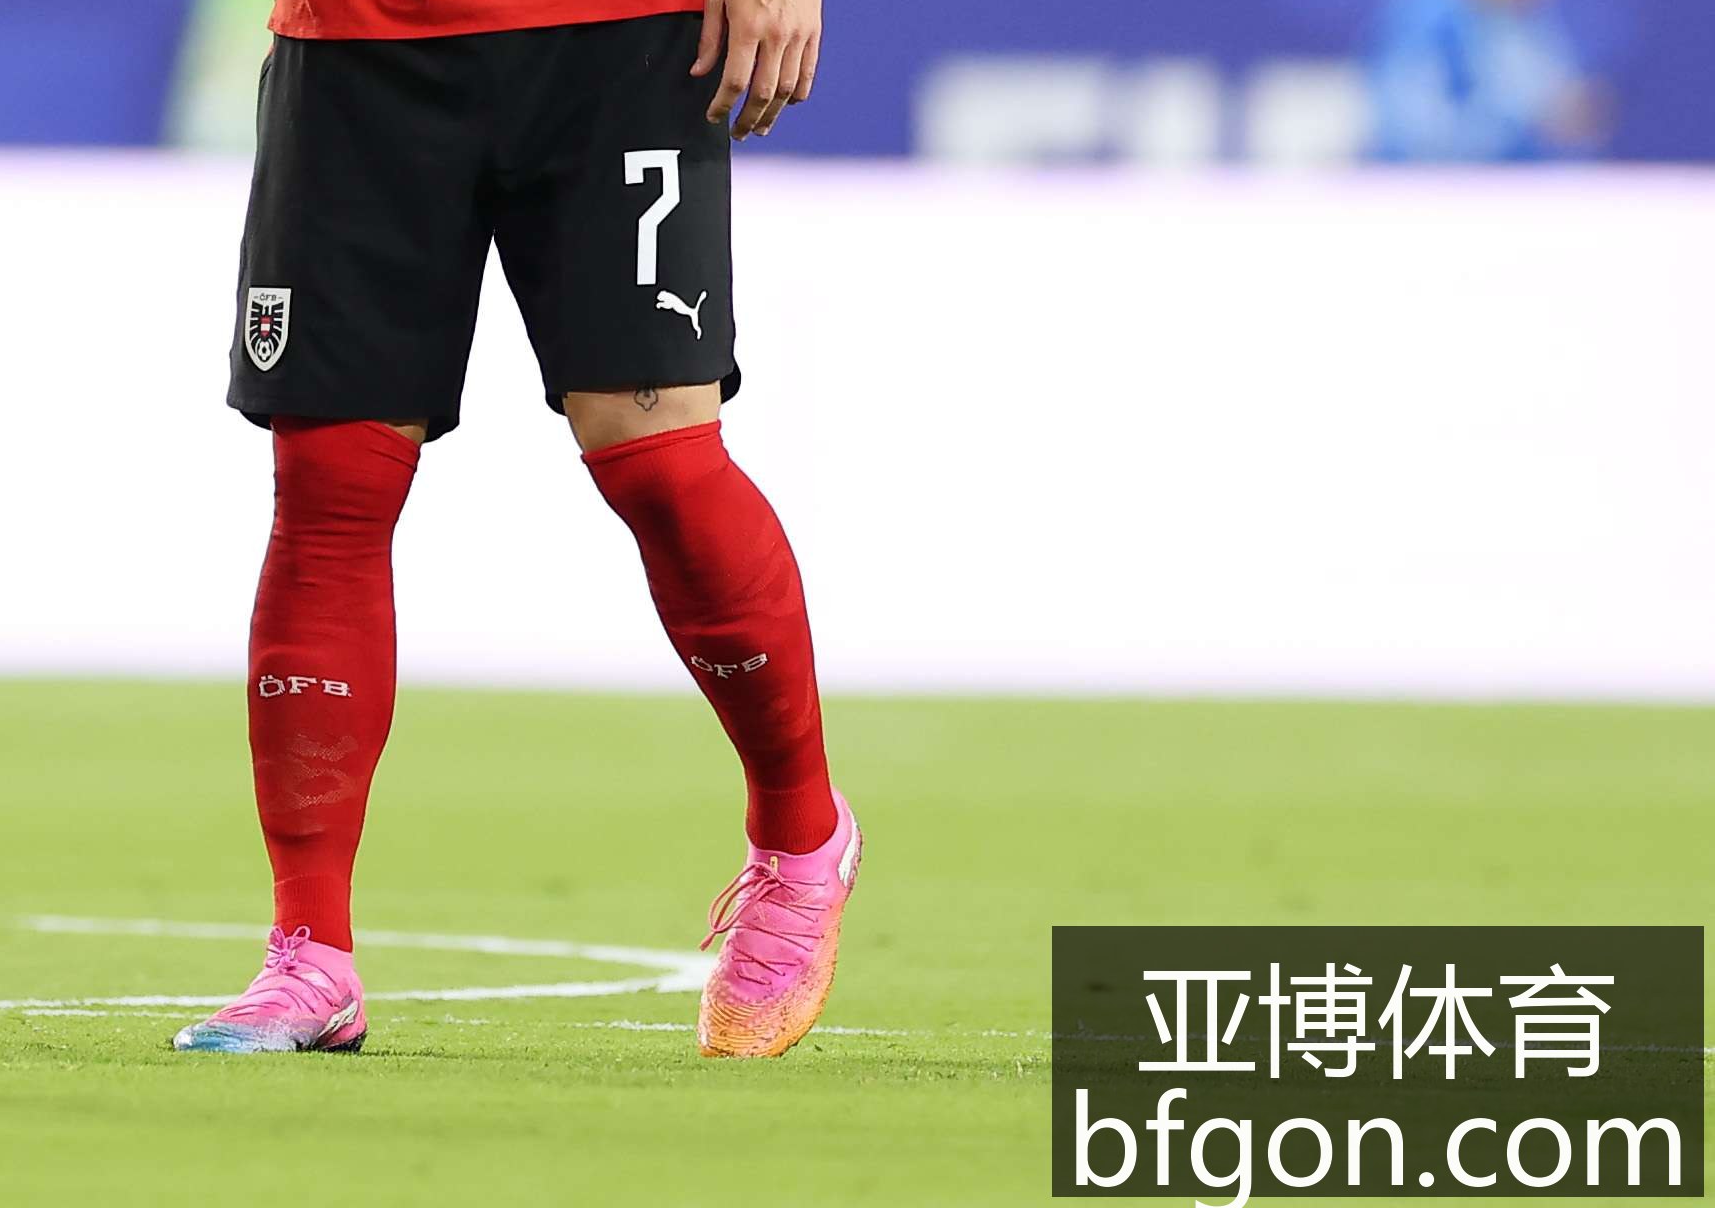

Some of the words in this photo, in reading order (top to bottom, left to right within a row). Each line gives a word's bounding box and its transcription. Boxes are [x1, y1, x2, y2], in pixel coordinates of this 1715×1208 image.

[623, 148, 682, 286] 7
[690, 653, 768, 679] ÖFB
[258, 674, 351, 698] ÖFB
